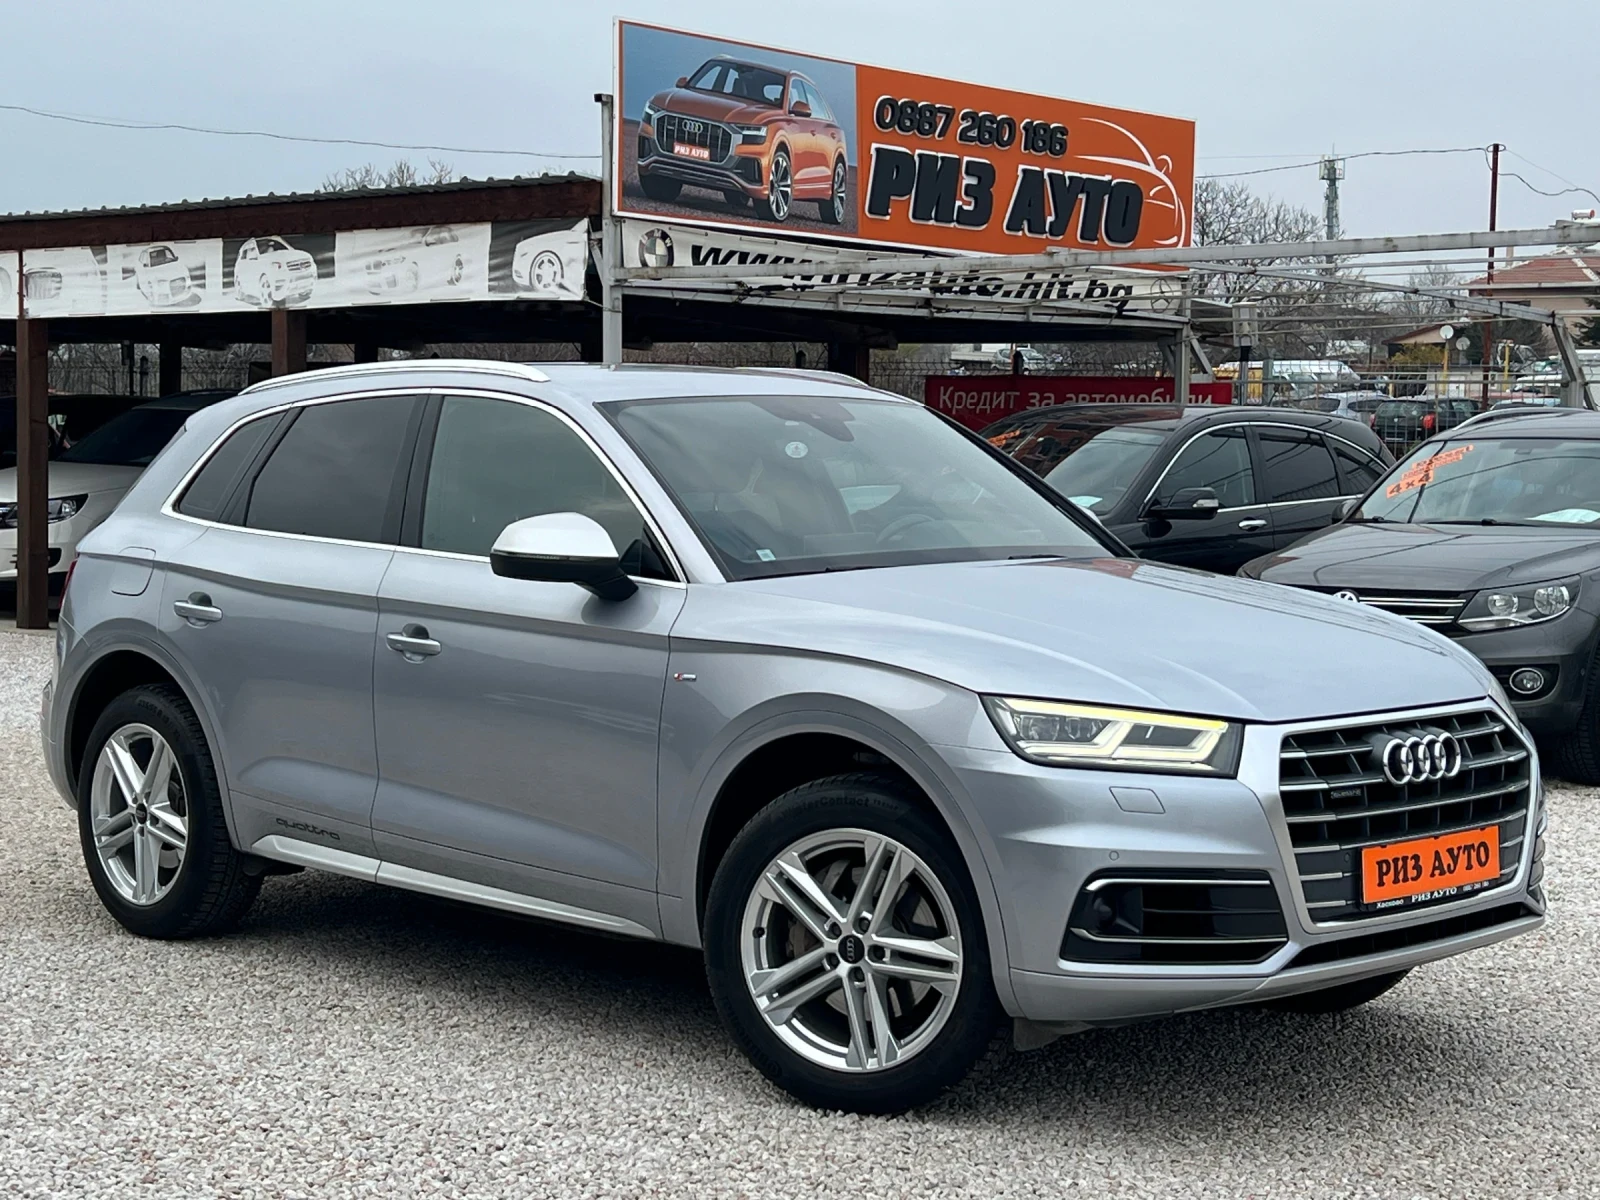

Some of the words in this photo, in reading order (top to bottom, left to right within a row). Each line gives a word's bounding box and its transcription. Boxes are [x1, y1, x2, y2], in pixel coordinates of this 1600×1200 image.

[874, 95, 955, 141] 0887
[956, 108, 1016, 150] 260
[1020, 118, 1069, 157] 186
[674, 144, 690, 155] РИЗ
[690, 148, 709, 159] АУТО
[865, 143, 996, 231] РИЗ
[1003, 164, 1143, 248] АУТО
[939, 385, 1020, 415] Кредит
[1026, 391, 1053, 410] за
[1063, 388, 1213, 406] автомоби
[275, 817, 341, 841] quattro
[1376, 853, 1423, 887] РИЗ
[1429, 841, 1490, 878] АУТО
[1411, 891, 1431, 903] РИЗ
[1431, 886, 1458, 899] АУТО
